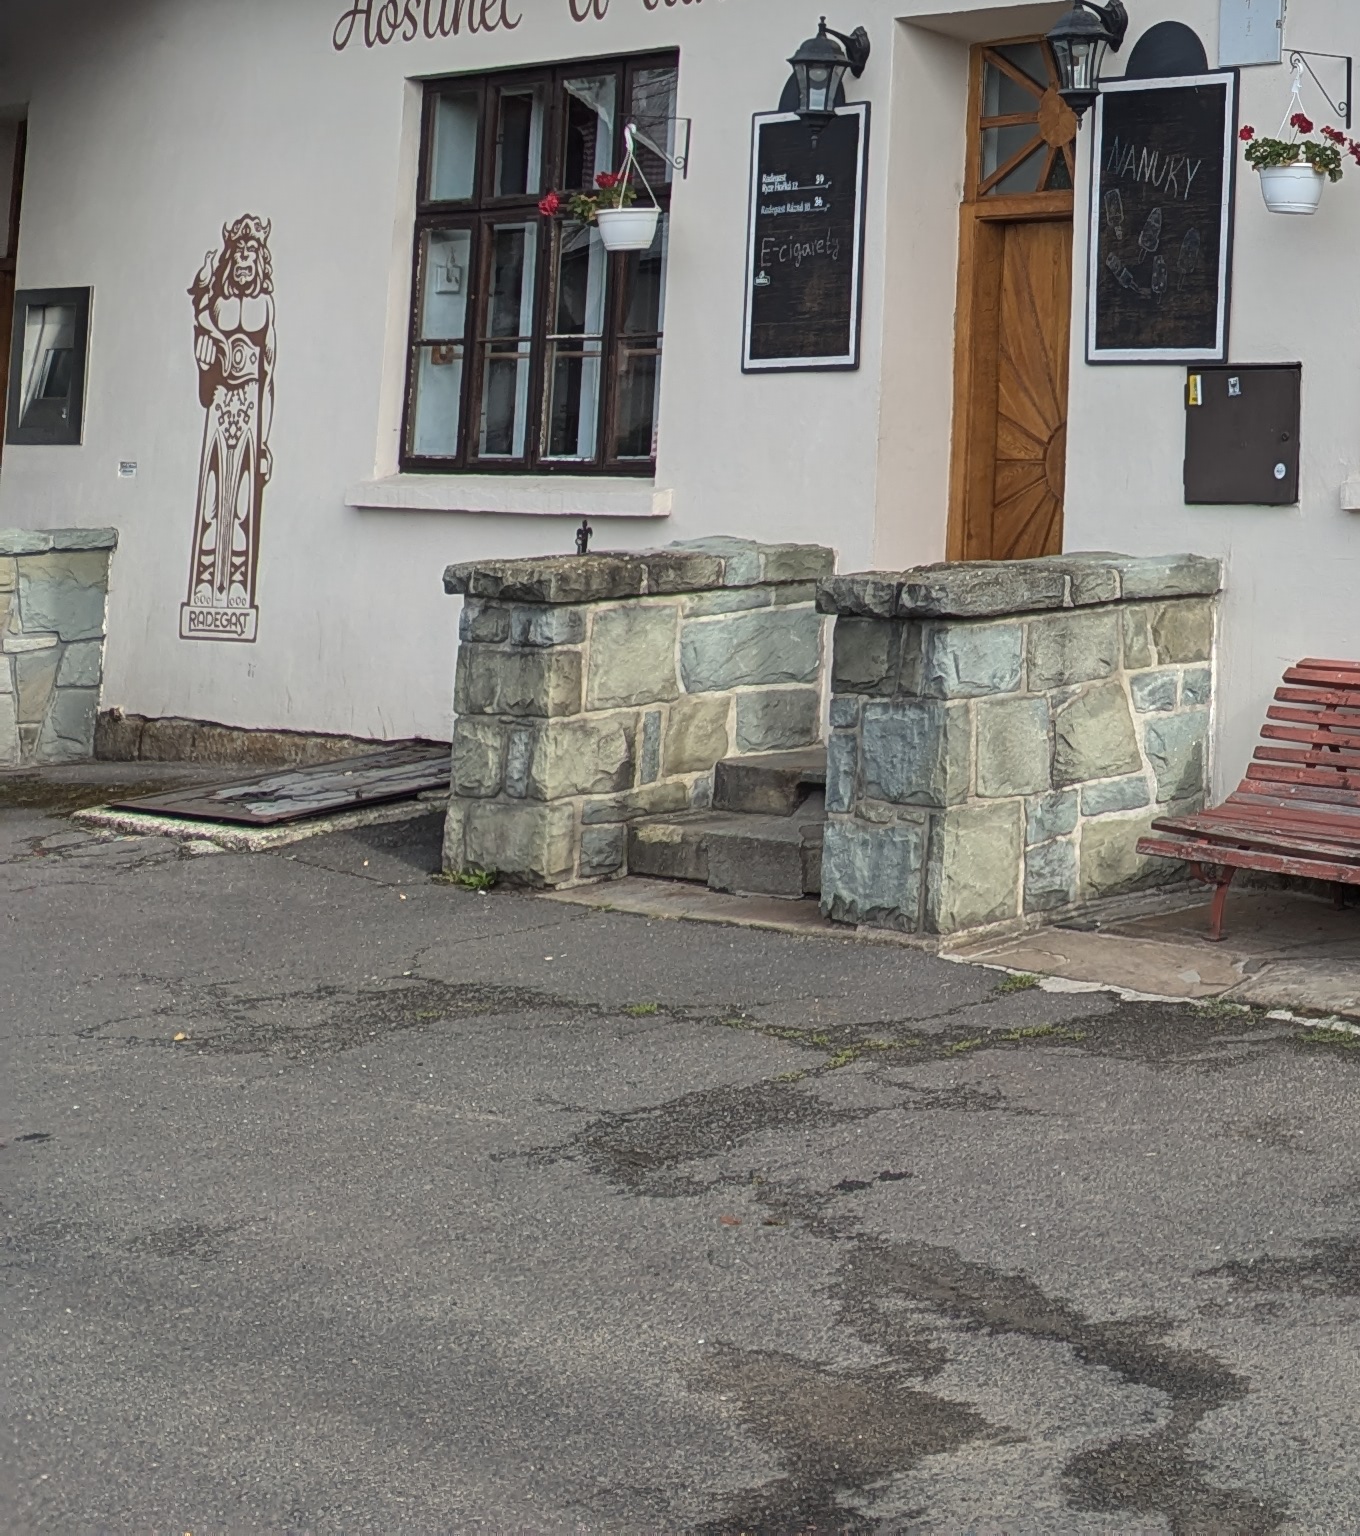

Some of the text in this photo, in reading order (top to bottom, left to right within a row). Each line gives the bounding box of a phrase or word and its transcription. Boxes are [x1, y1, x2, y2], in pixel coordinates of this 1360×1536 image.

[1106, 136, 1202, 200] NANUKY
[760, 227, 840, 267] E-cigarety
[188, 610, 250, 636] RADEGAST
